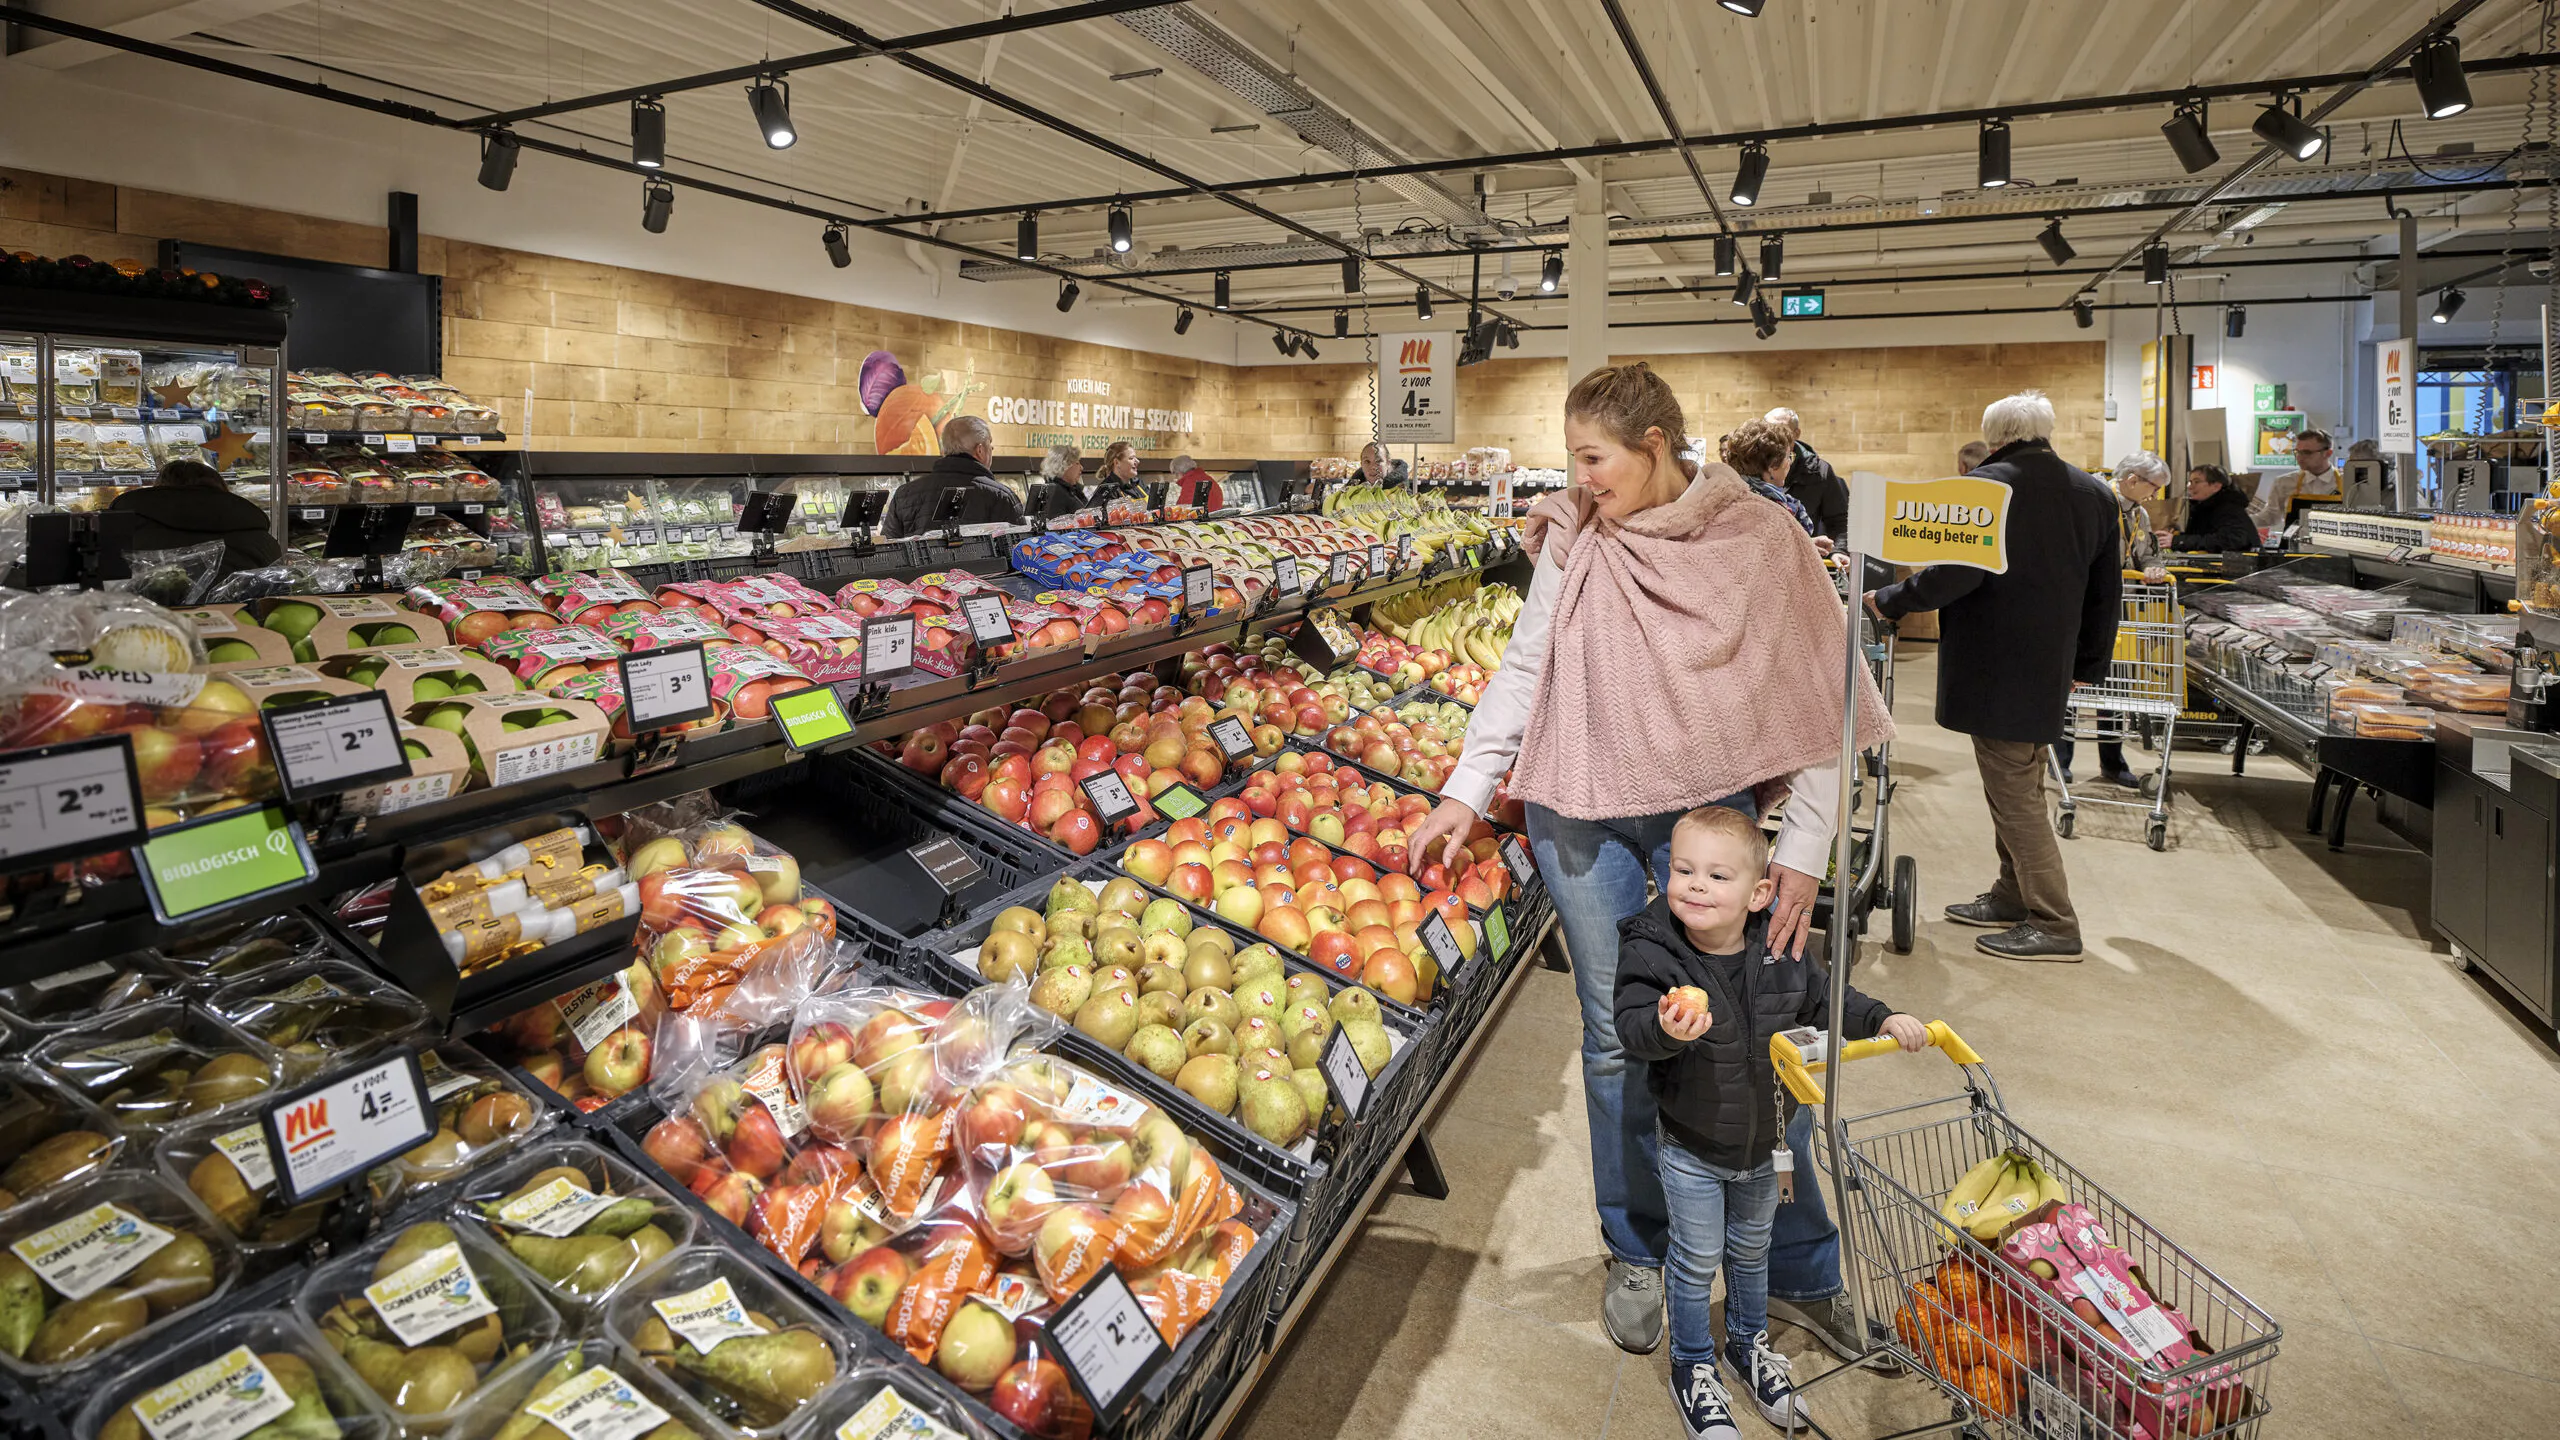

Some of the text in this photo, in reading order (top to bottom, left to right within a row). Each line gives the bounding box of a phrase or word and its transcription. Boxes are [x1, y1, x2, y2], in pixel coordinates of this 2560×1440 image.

[1067, 379, 1111, 397] KOKEN MET
[1402, 377, 1431, 387] 2 VOOR
[988, 396, 1193, 433] GROENTE EN FRUIT VAN SEIZOEN
[1081, 434, 1109, 450] VERSER
[1893, 501, 1994, 527] JUMBO
[1892, 525, 1979, 545] elke dag beter
[1023, 564, 1039, 576] JAZZ
[868, 624, 898, 636] Pink kids
[814, 662, 843, 679] Pink
[914, 650, 958, 676] Pink Lady
[78, 670, 152, 684] APPELS
[786, 710, 827, 727] BIOLOGISCH
[2176, 711, 2218, 720] UMBO
[162, 845, 260, 883] BIOLOGISCH
[563, 987, 594, 1017] ELSTAR
[352, 1070, 388, 1093] 2 VOOR
[36, 1215, 127, 1268] CONFERENCE
[382, 1265, 466, 1312] CONFERENCE
[670, 1299, 736, 1324] CONFERENCE
[152, 1364, 256, 1426] CONFERENCE
[552, 1379, 623, 1420] CONFERENCE
